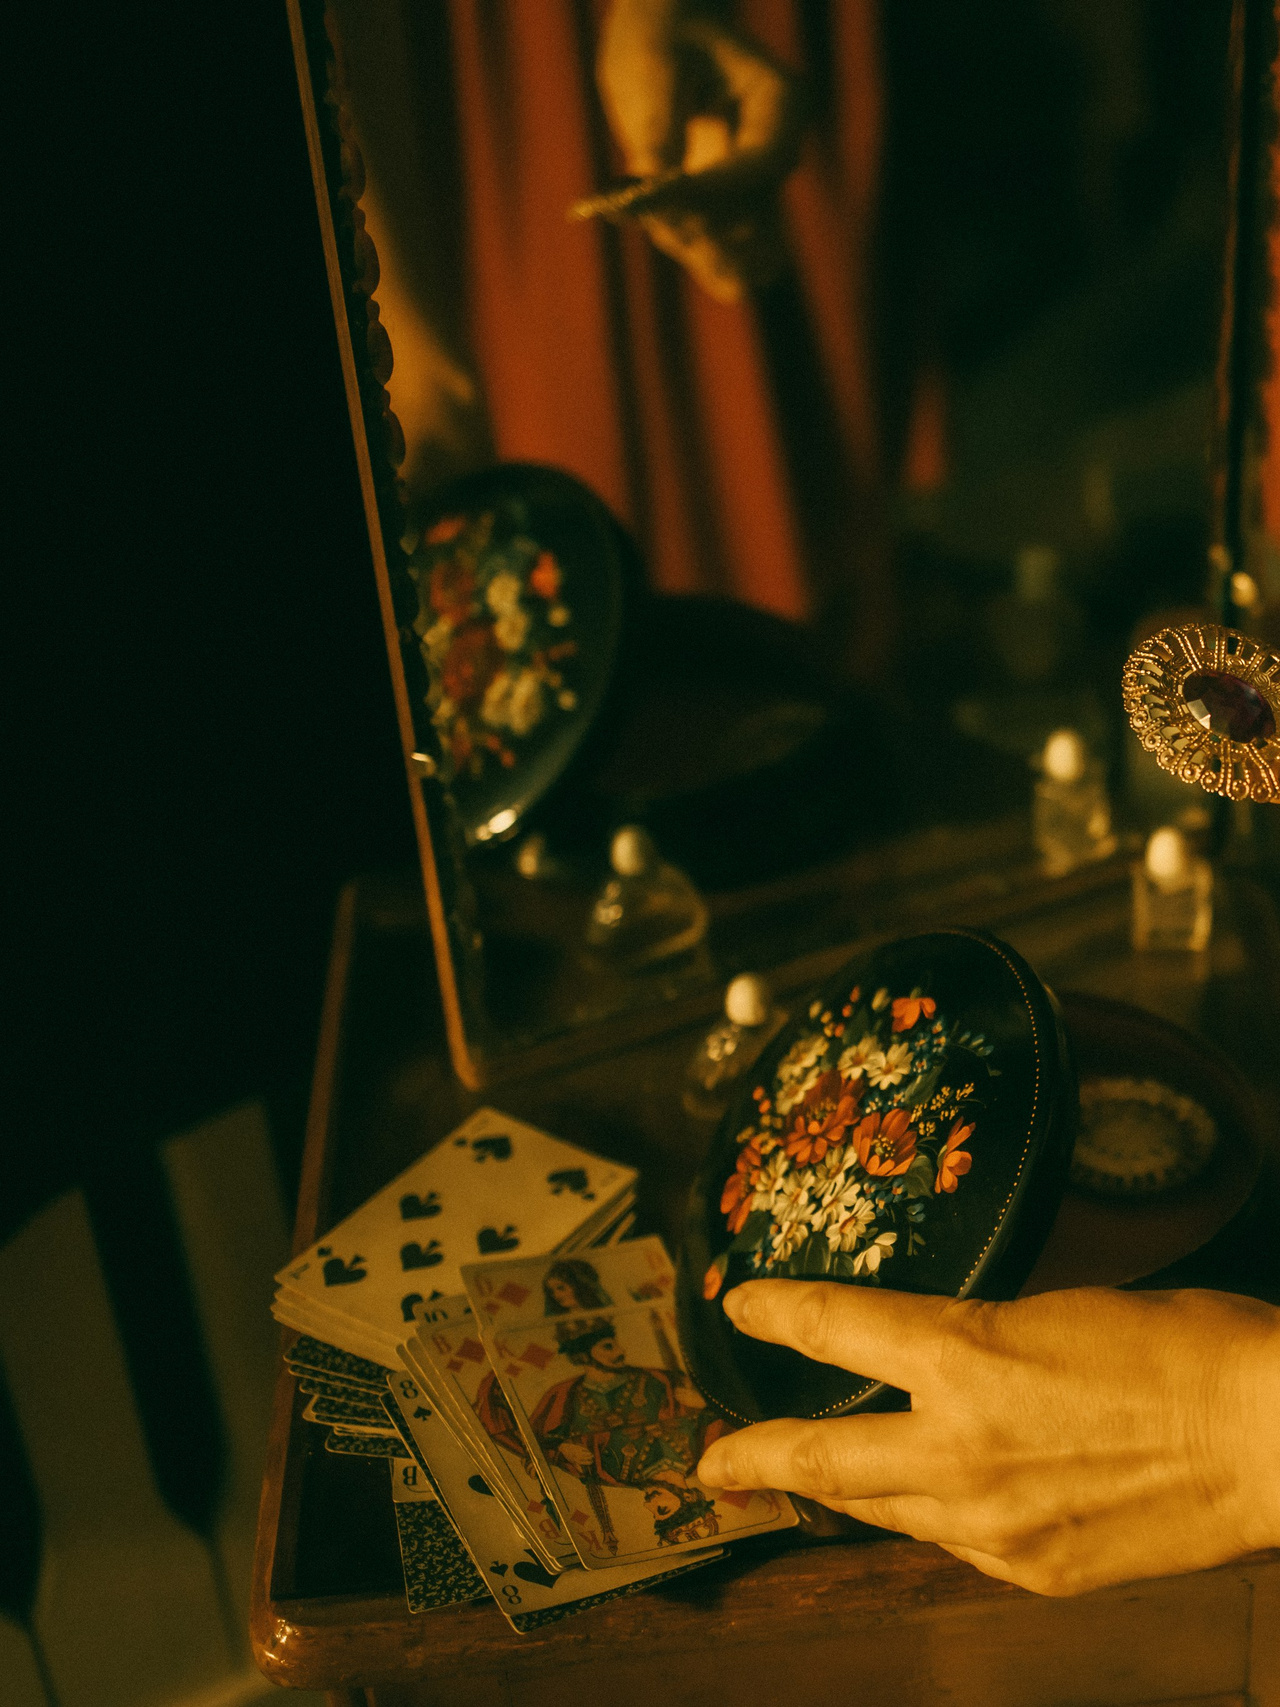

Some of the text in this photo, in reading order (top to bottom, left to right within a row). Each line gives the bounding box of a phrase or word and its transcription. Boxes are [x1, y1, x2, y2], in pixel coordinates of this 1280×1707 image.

[400, 1380, 418, 1399] 8
[402, 1465, 417, 1486] B
[539, 1518, 560, 1539] B
[578, 1529, 602, 1551] K
[501, 1584, 522, 1605] 8
